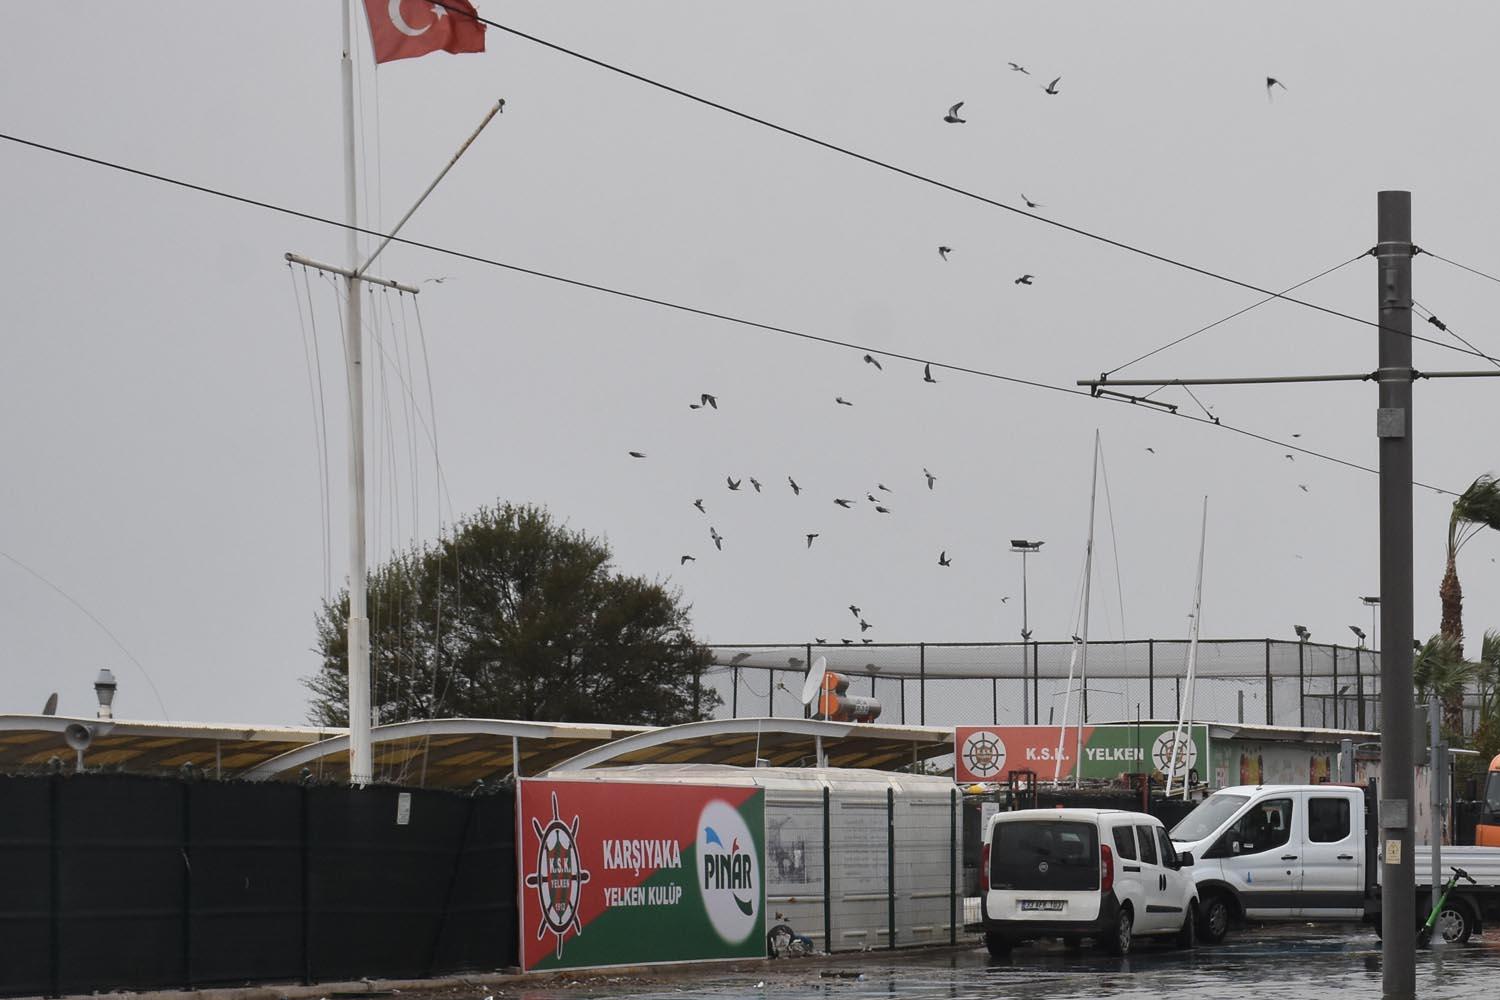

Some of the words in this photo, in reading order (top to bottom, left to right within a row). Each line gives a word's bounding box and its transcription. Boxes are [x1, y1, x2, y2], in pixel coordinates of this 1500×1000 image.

[1026, 748, 1070, 760] K.S.K.
[1086, 748, 1144, 760] YELKEN
[603, 839, 682, 877] KARŞIYAKA
[704, 853, 752, 890] PINAR
[604, 887, 646, 907] YELKEN
[648, 882, 682, 905] KULÜP
